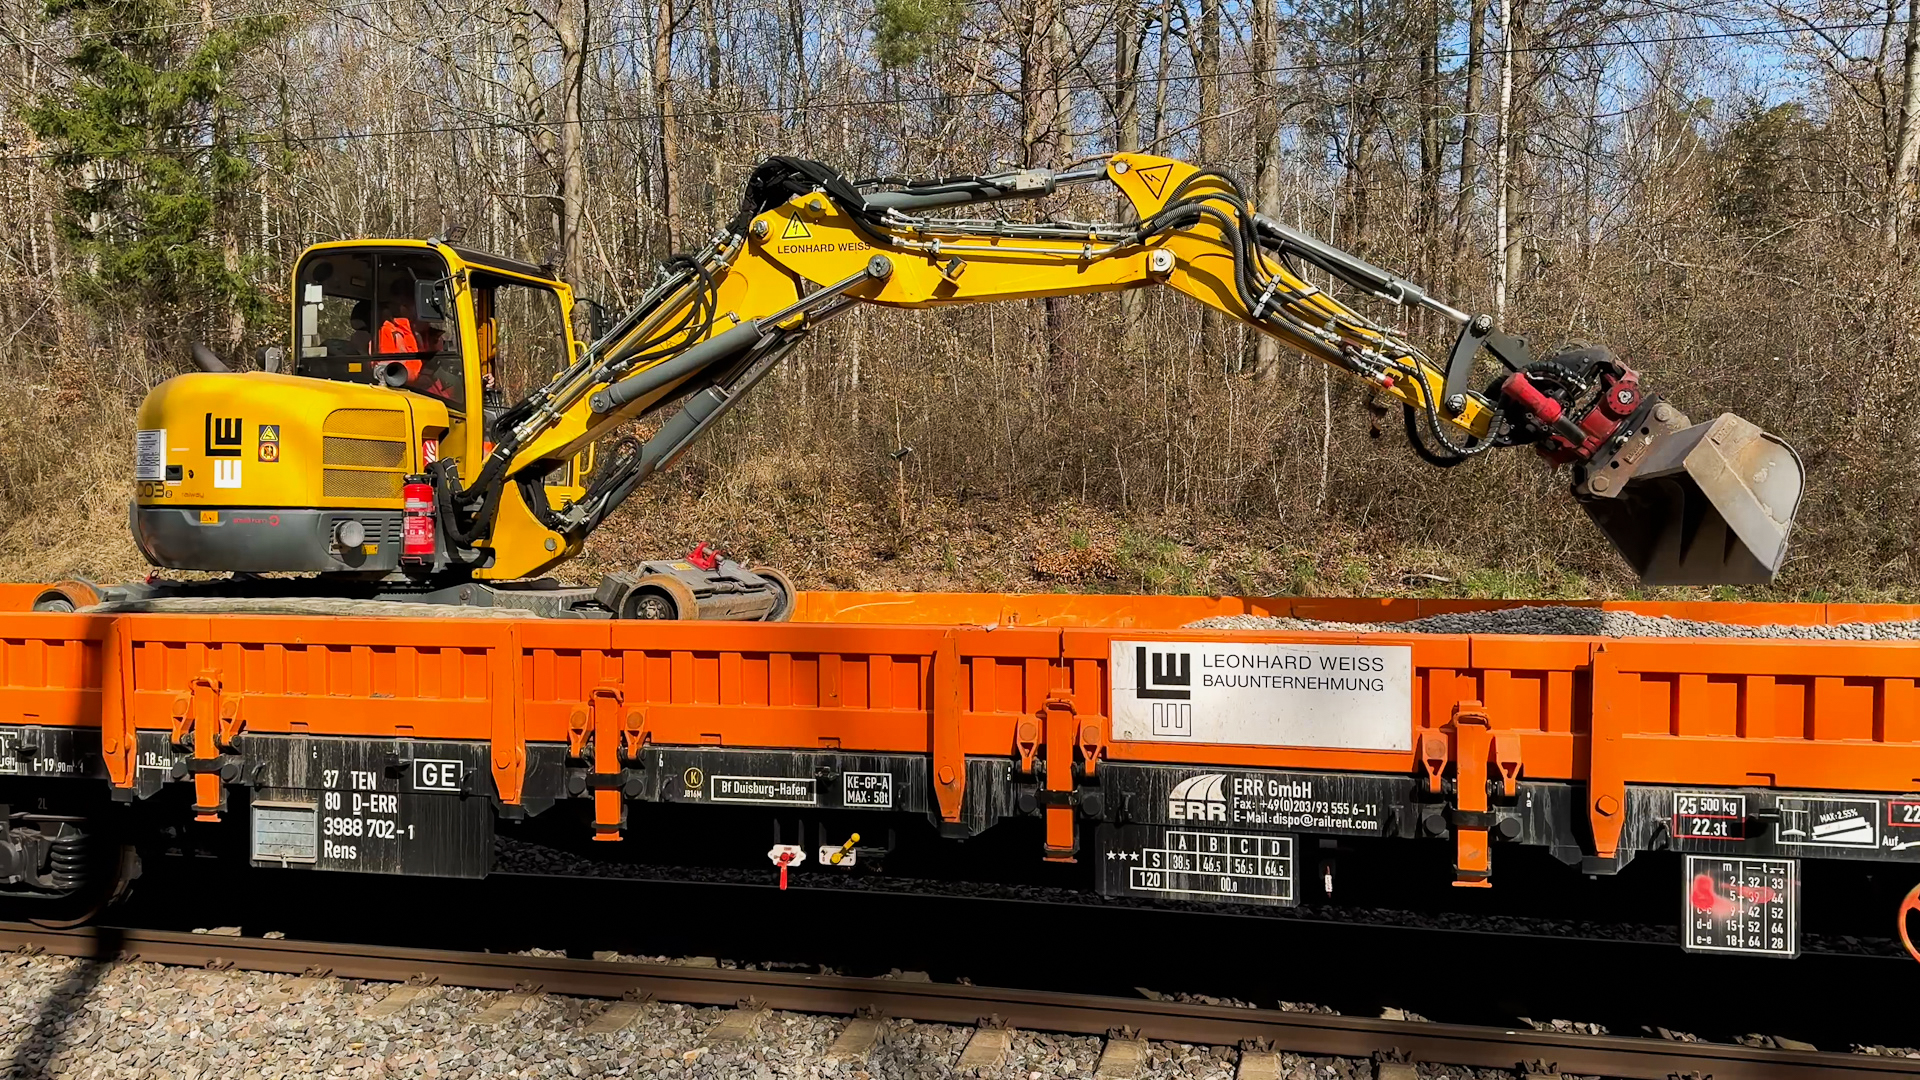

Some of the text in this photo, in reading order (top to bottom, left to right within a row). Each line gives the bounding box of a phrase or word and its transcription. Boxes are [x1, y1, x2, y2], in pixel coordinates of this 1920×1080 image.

[778, 242, 871, 254] LEONHARD WEISS
[1203, 654, 1384, 672] LEONHARD WEISS
[1203, 675, 1384, 692] BAUUNTERNEHMUNG
[324, 770, 377, 790] 37 TEN
[422, 763, 456, 787] GE
[690, 772, 698, 784] K
[847, 776, 889, 790] KE-GP-A
[722, 781, 807, 798] Bf Duisburg-Hafen
[847, 790, 871, 803] MAX:
[1234, 778, 1312, 799] ERR GmbH
[325, 792, 397, 815] 80 D-ERR
[1168, 801, 1227, 822] ERR
[1234, 797, 1377, 817] Fax: +49(0)203/93 555 6-11
[1679, 798, 1737, 814] 25 500 kg
[324, 818, 362, 836] 3988
[1692, 819, 1727, 836] 22.3t
[324, 840, 357, 859] Rens
[1178, 835, 1280, 856] A B C D
[1882, 835, 1899, 847] Auf
[1152, 853, 1284, 877] S 38.5 46.5 56.5 64.5
[1723, 863, 1767, 873] m t
[1140, 872, 1160, 887] 120
[1730, 876, 1784, 889] 2 32 33
[1730, 891, 1736, 901] 5
[1771, 893, 1784, 904] 44
[1748, 907, 1760, 917] 42
[1771, 908, 1784, 918] 52
[1696, 918, 1784, 933] d-d 15 52 64
[1696, 935, 1784, 948] e-e 18 64 28
